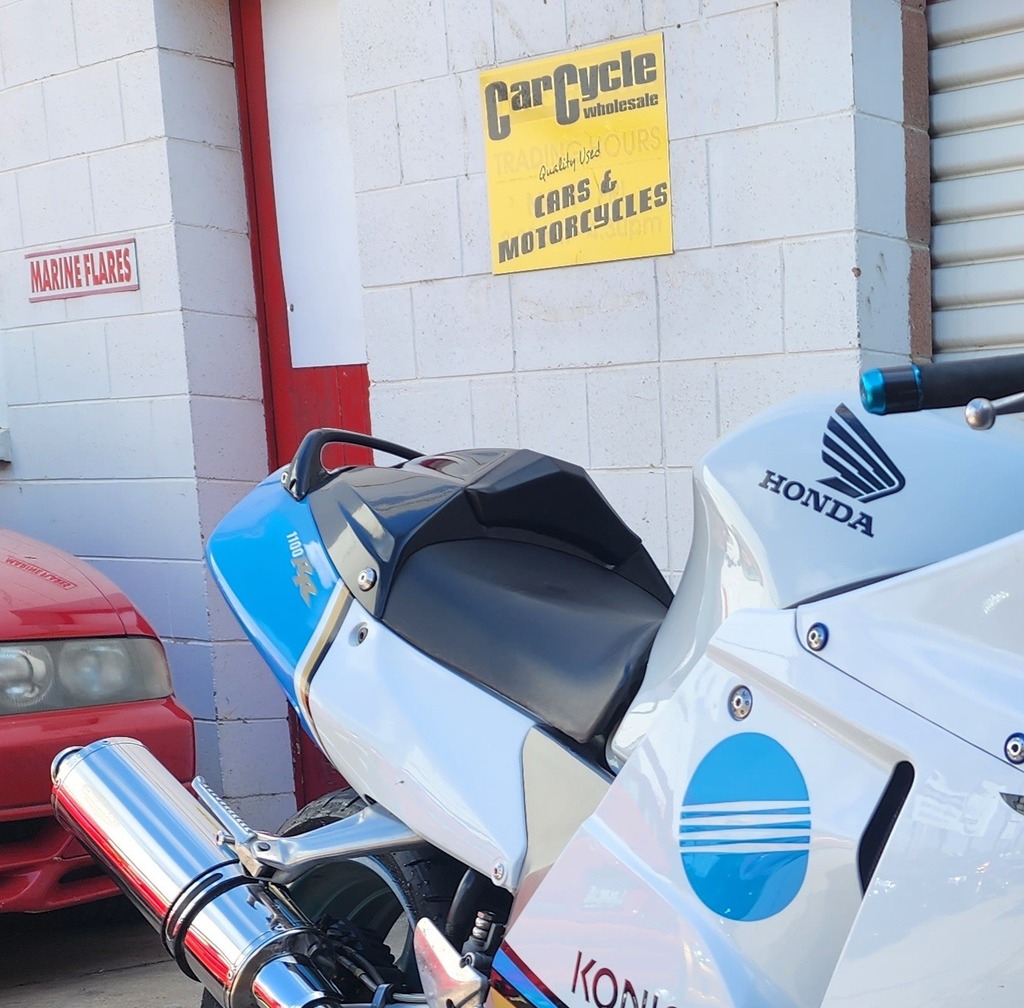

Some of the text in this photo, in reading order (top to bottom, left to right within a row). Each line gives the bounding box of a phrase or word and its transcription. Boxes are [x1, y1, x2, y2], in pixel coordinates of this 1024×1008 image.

[484, 49, 657, 141] CarCycle
[583, 92, 659, 119] wholesale
[538, 141, 601, 182] Quality Used
[534, 177, 591, 219] CARS
[600, 169, 618, 194] &
[498, 181, 668, 264] MOTORCYCLES
[30, 247, 132, 293] MARINE FLARES
[758, 469, 875, 538] HONDA
[286, 531, 304, 558] 1100
